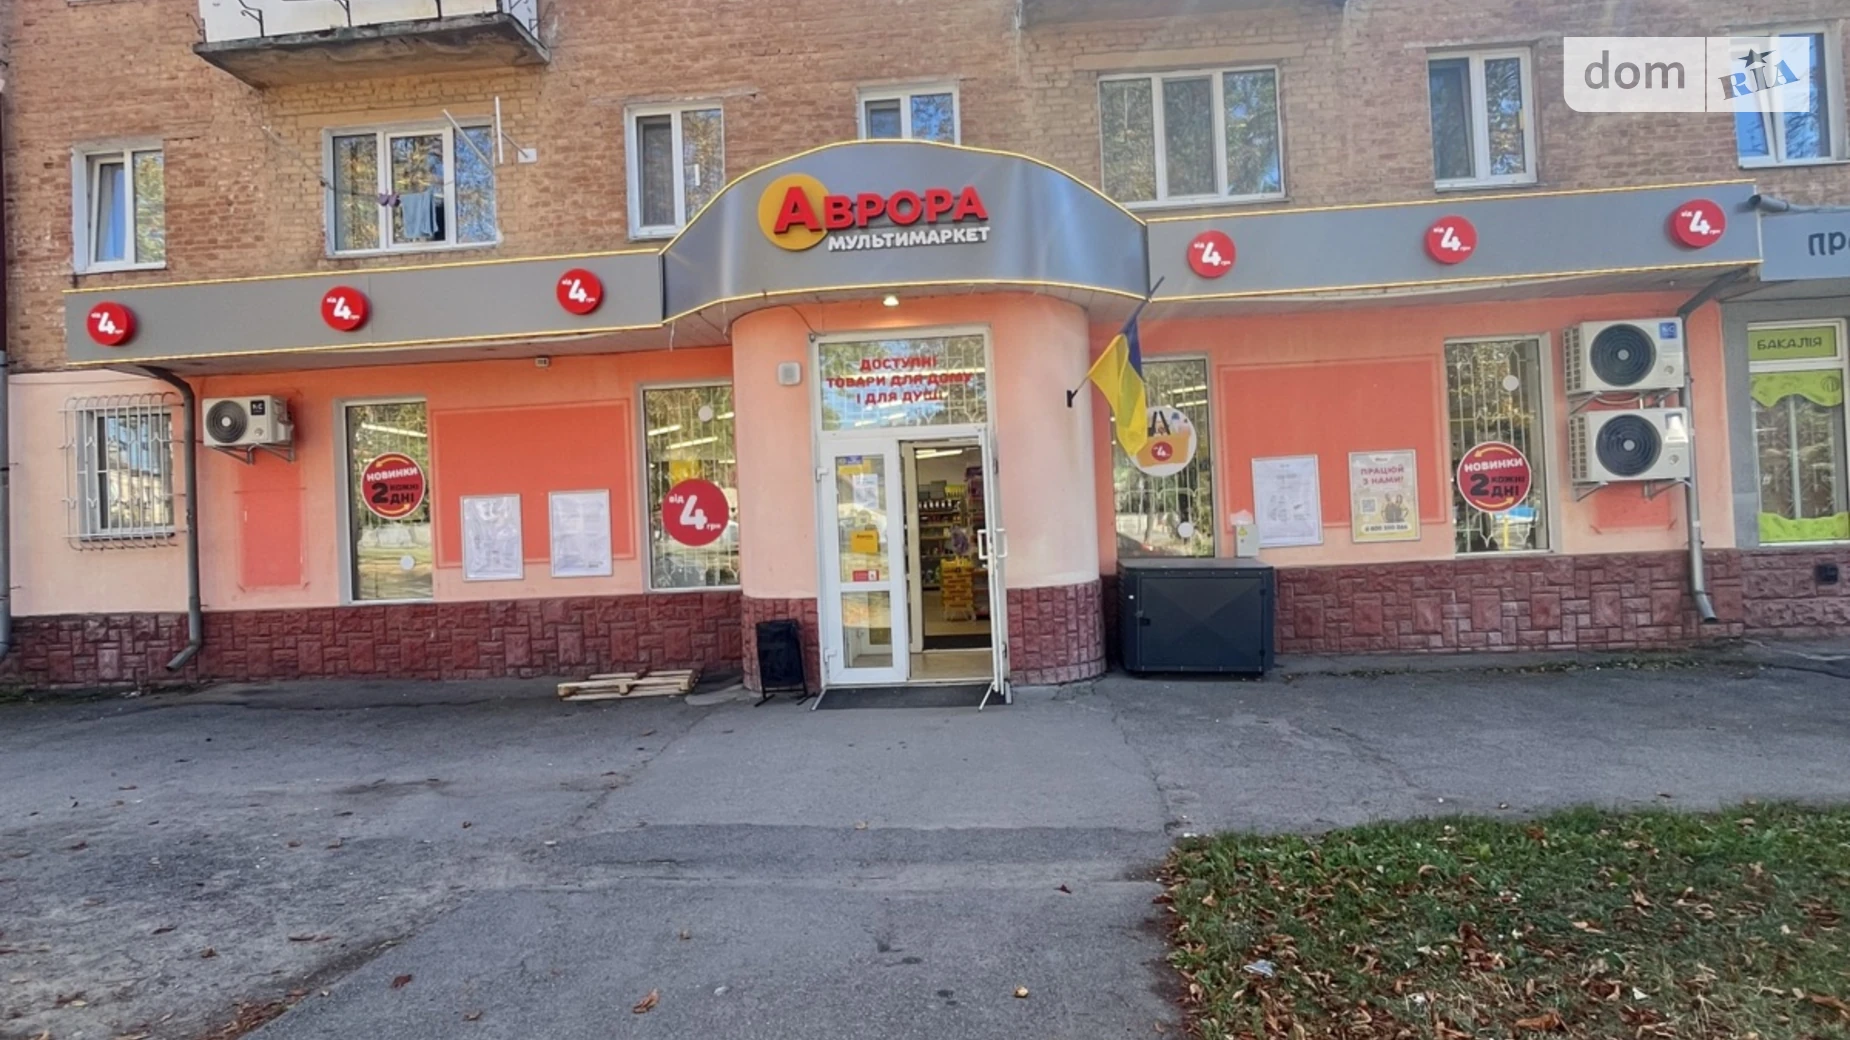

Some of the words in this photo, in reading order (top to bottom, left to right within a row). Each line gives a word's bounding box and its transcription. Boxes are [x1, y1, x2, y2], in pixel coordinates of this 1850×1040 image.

[1690, 210, 1710, 235] 4
[828, 227, 990, 251] МУЛЬТИМАРКЕТ
[1441, 227, 1461, 251] 4
[1202, 242, 1221, 266] 4
[569, 279, 587, 302] 4
[334, 296, 351, 319] 4
[98, 312, 115, 334] 4
[1757, 336, 1823, 350] БАКАЛІЯ
[859, 355, 937, 371] ДОСТУПНІ
[826, 376, 886, 388] ТОВАРИ
[889, 374, 924, 387] ДЛЯ
[926, 372, 973, 385] ДОМУ
[864, 391, 898, 405] ДЛЯ
[366, 467, 418, 482] НОВИНКИ
[1360, 464, 1405, 476] ПРАЦЮЙ
[1464, 459, 1523, 472] НОВИНКИ
[371, 482, 389, 504] 2
[1470, 473, 1490, 496] 2
[1491, 486, 1519, 498] ДНІ
[390, 493, 415, 505] ДНІ
[668, 494, 685, 505] від
[680, 495, 707, 530] 4
